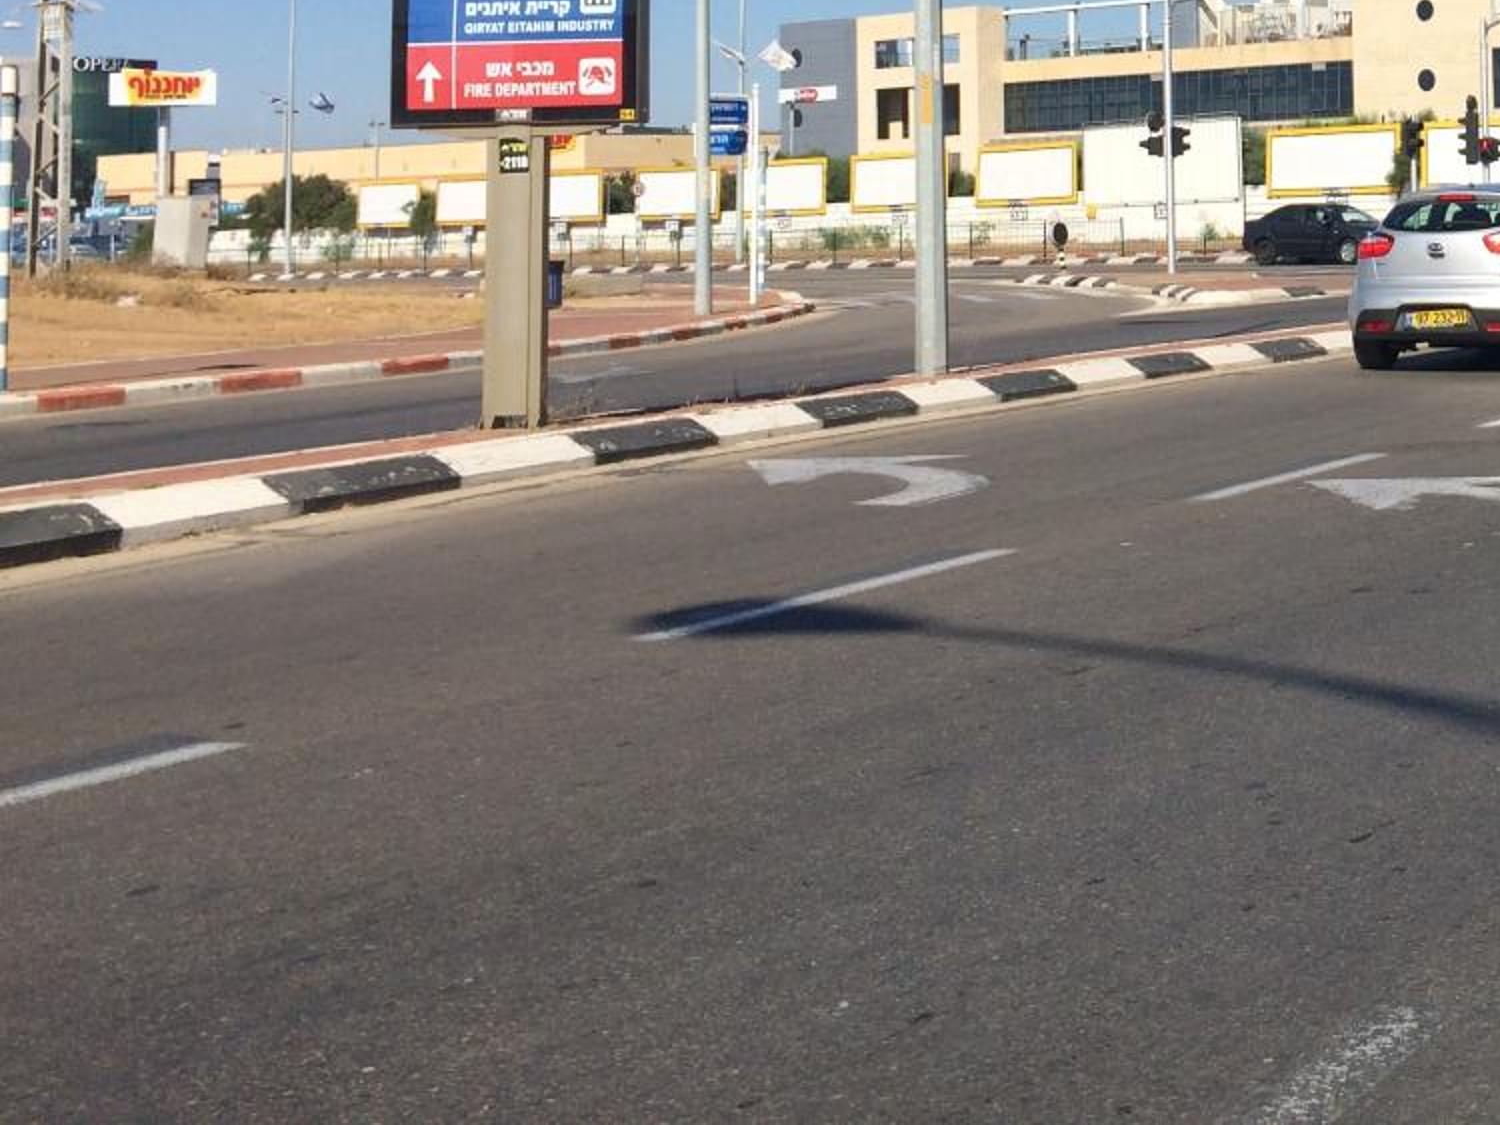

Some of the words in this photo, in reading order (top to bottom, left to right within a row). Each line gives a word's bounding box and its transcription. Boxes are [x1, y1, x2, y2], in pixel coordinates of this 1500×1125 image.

[465, 1, 521, 17] איתנים
[524, 0, 571, 17] קריית
[464, 21, 505, 35] QIRYAT
[557, 18, 615, 33] INDUSTRY
[485, 62, 512, 78] אש
[516, 61, 555, 76] מכבי
[463, 82, 493, 98] FIRE
[495, 81, 577, 97] DEPARTMENT
